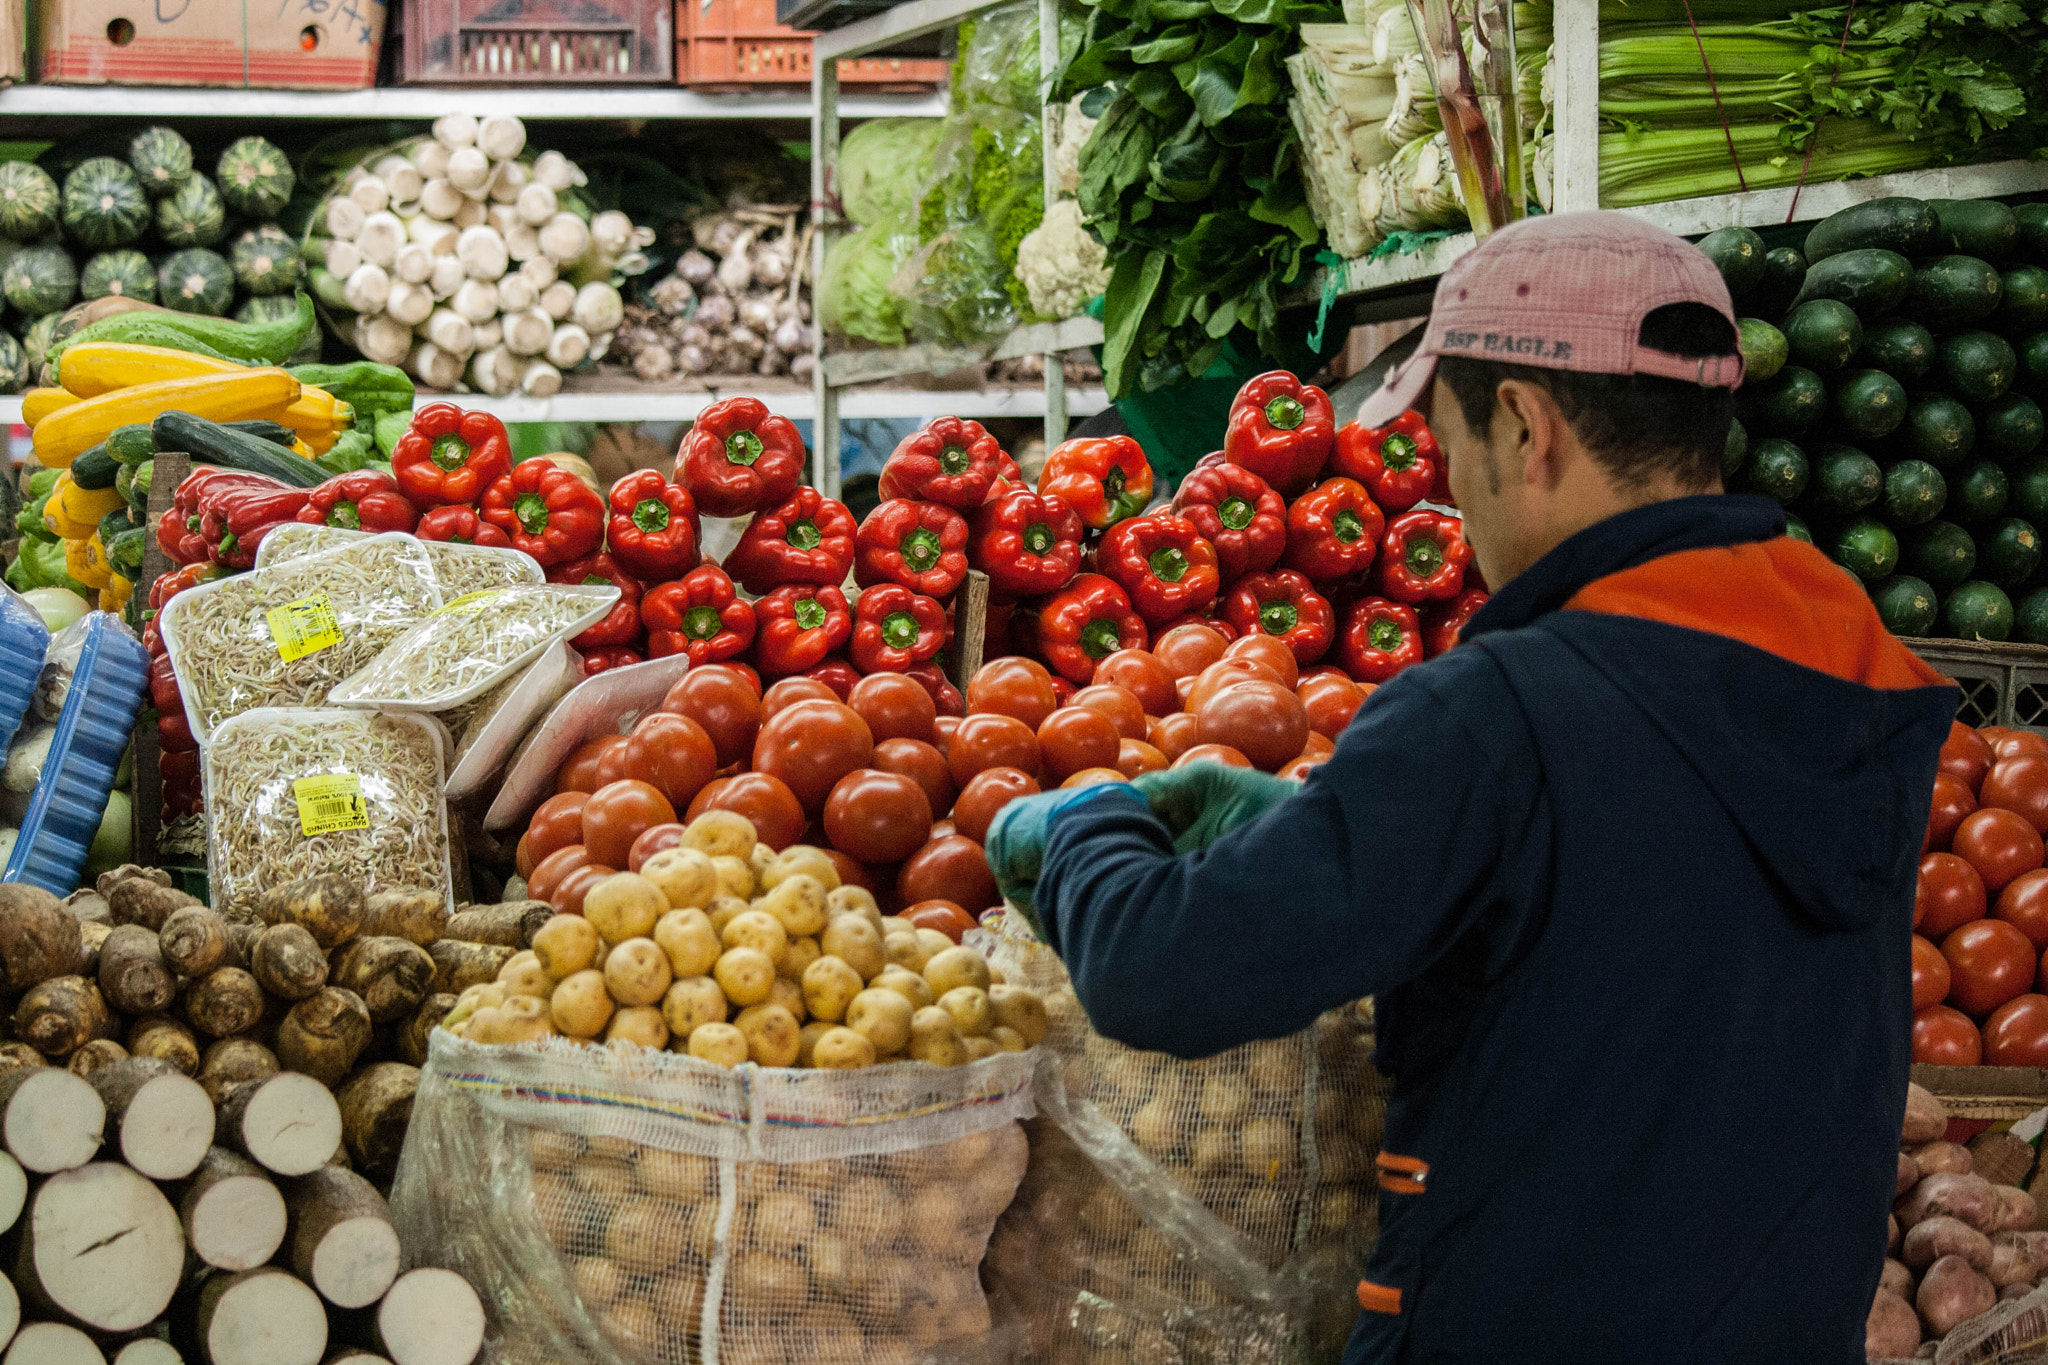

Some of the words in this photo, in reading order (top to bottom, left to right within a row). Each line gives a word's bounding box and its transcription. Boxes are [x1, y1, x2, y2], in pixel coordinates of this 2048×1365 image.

[1483, 332, 1572, 360] EAGLE
[306, 823, 336, 833] CHINAS
[338, 819, 367, 828] RAICES
